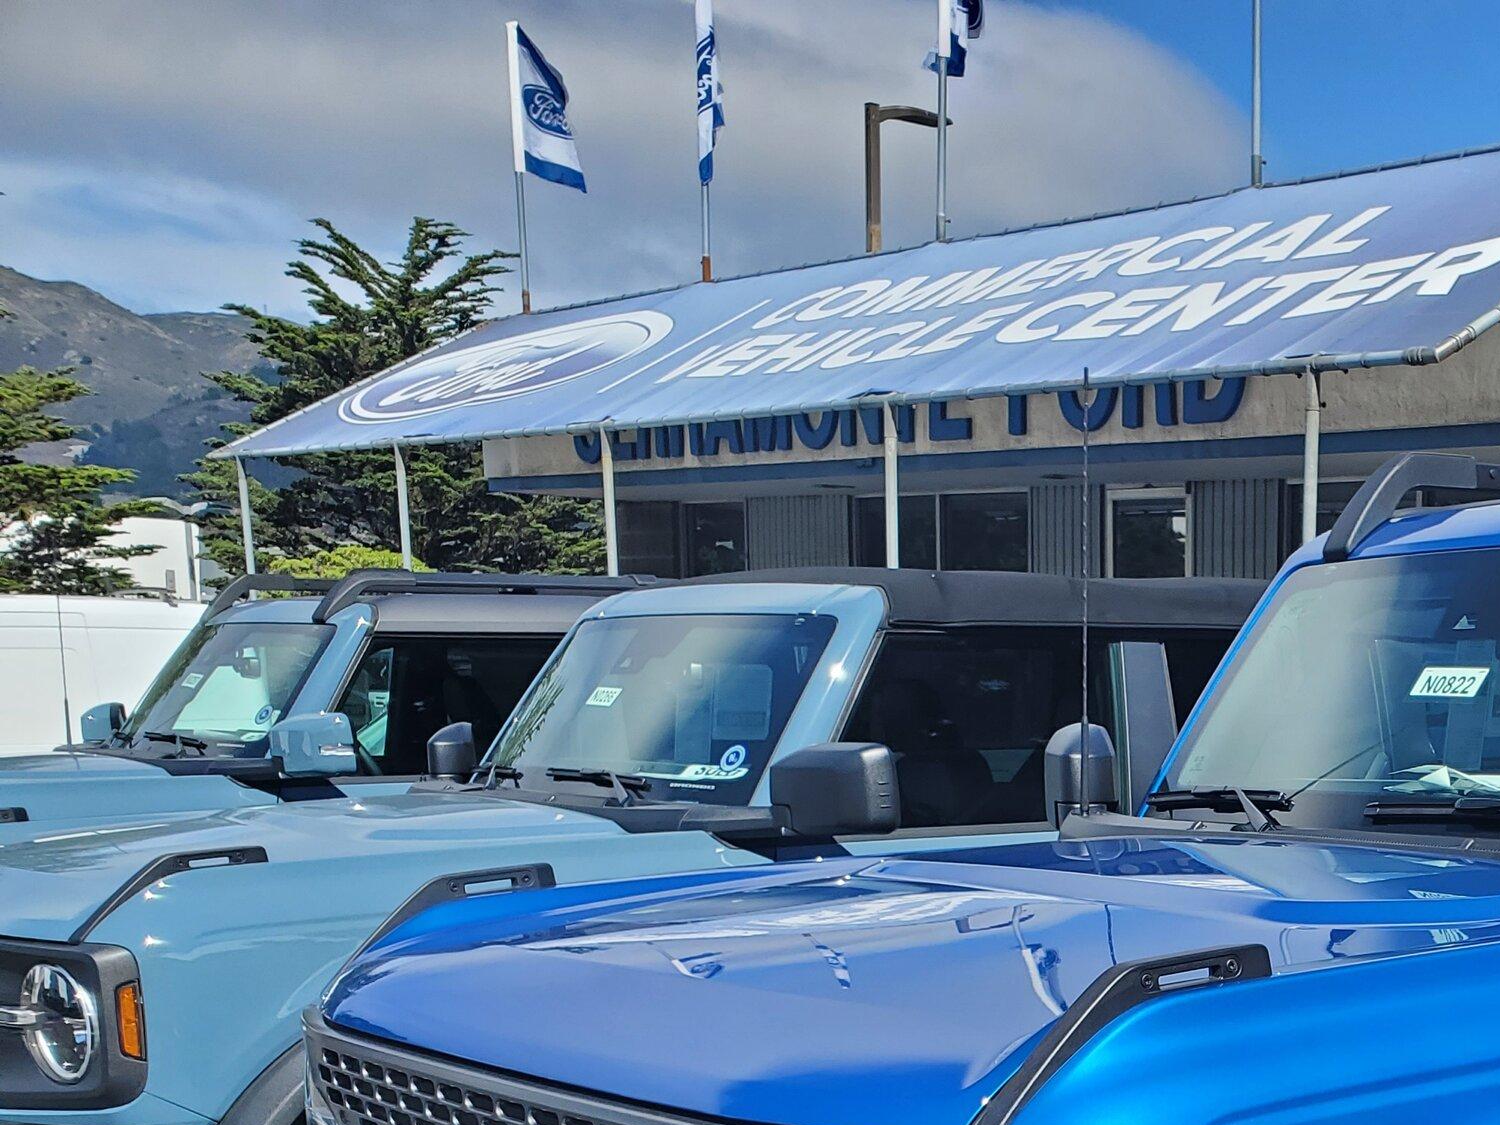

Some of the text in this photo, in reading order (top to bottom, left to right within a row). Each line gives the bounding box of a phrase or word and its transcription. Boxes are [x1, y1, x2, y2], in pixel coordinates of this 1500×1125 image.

[752, 206, 1392, 330] COMMERCIAL
[654, 301, 1033, 384] VEHICLE
[1420, 675, 1476, 695] N0822
